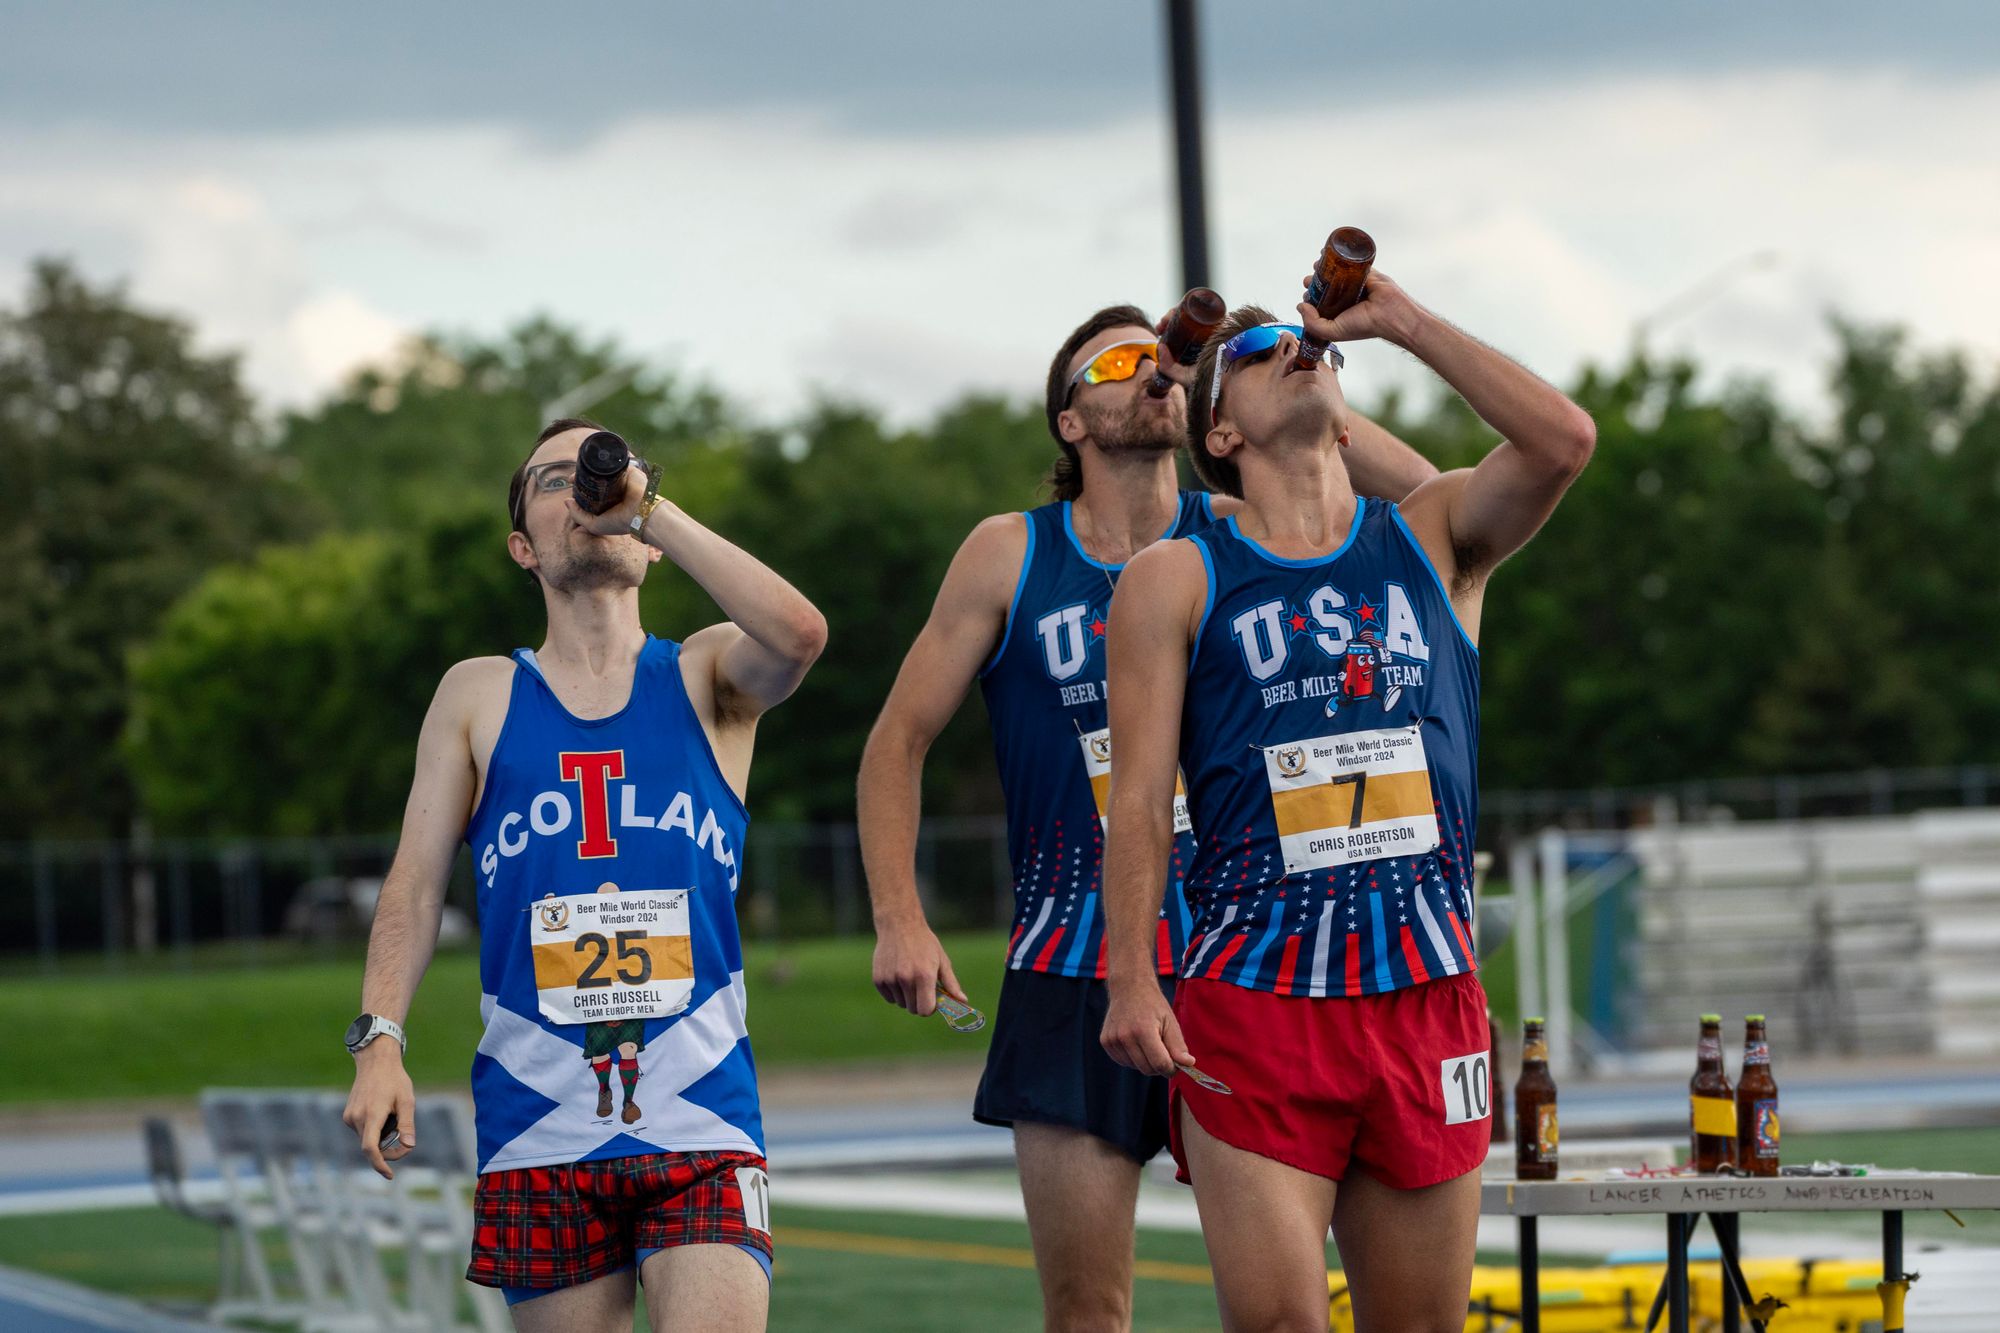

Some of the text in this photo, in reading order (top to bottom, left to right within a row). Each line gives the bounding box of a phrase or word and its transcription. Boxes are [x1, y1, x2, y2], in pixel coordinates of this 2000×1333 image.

[1230, 581, 1429, 684] USA
[1059, 680, 1099, 707] BEER
[1261, 665, 1424, 709] BEER MILE TEAM
[1313, 736, 1413, 759] Beer Mile World Classic
[1336, 751, 1395, 767] Windsor 2024
[1331, 771, 1367, 830] 7
[1309, 827, 1415, 854] CHRIS ROBERTSON
[1347, 846, 1382, 859] USA MEN
[577, 899, 678, 914] Beer Mile World Classic
[599, 912, 658, 925] Windsor 2024
[574, 930, 652, 990] 25
[574, 990, 662, 1008] CHRIS RUSSELL
[583, 1004, 655, 1018] TEAM EUROPE MEN
[1452, 1057, 1488, 1120] 10
[1589, 1186, 1662, 1203] LANCER
[1828, 1185, 1934, 1201] RECREATION
